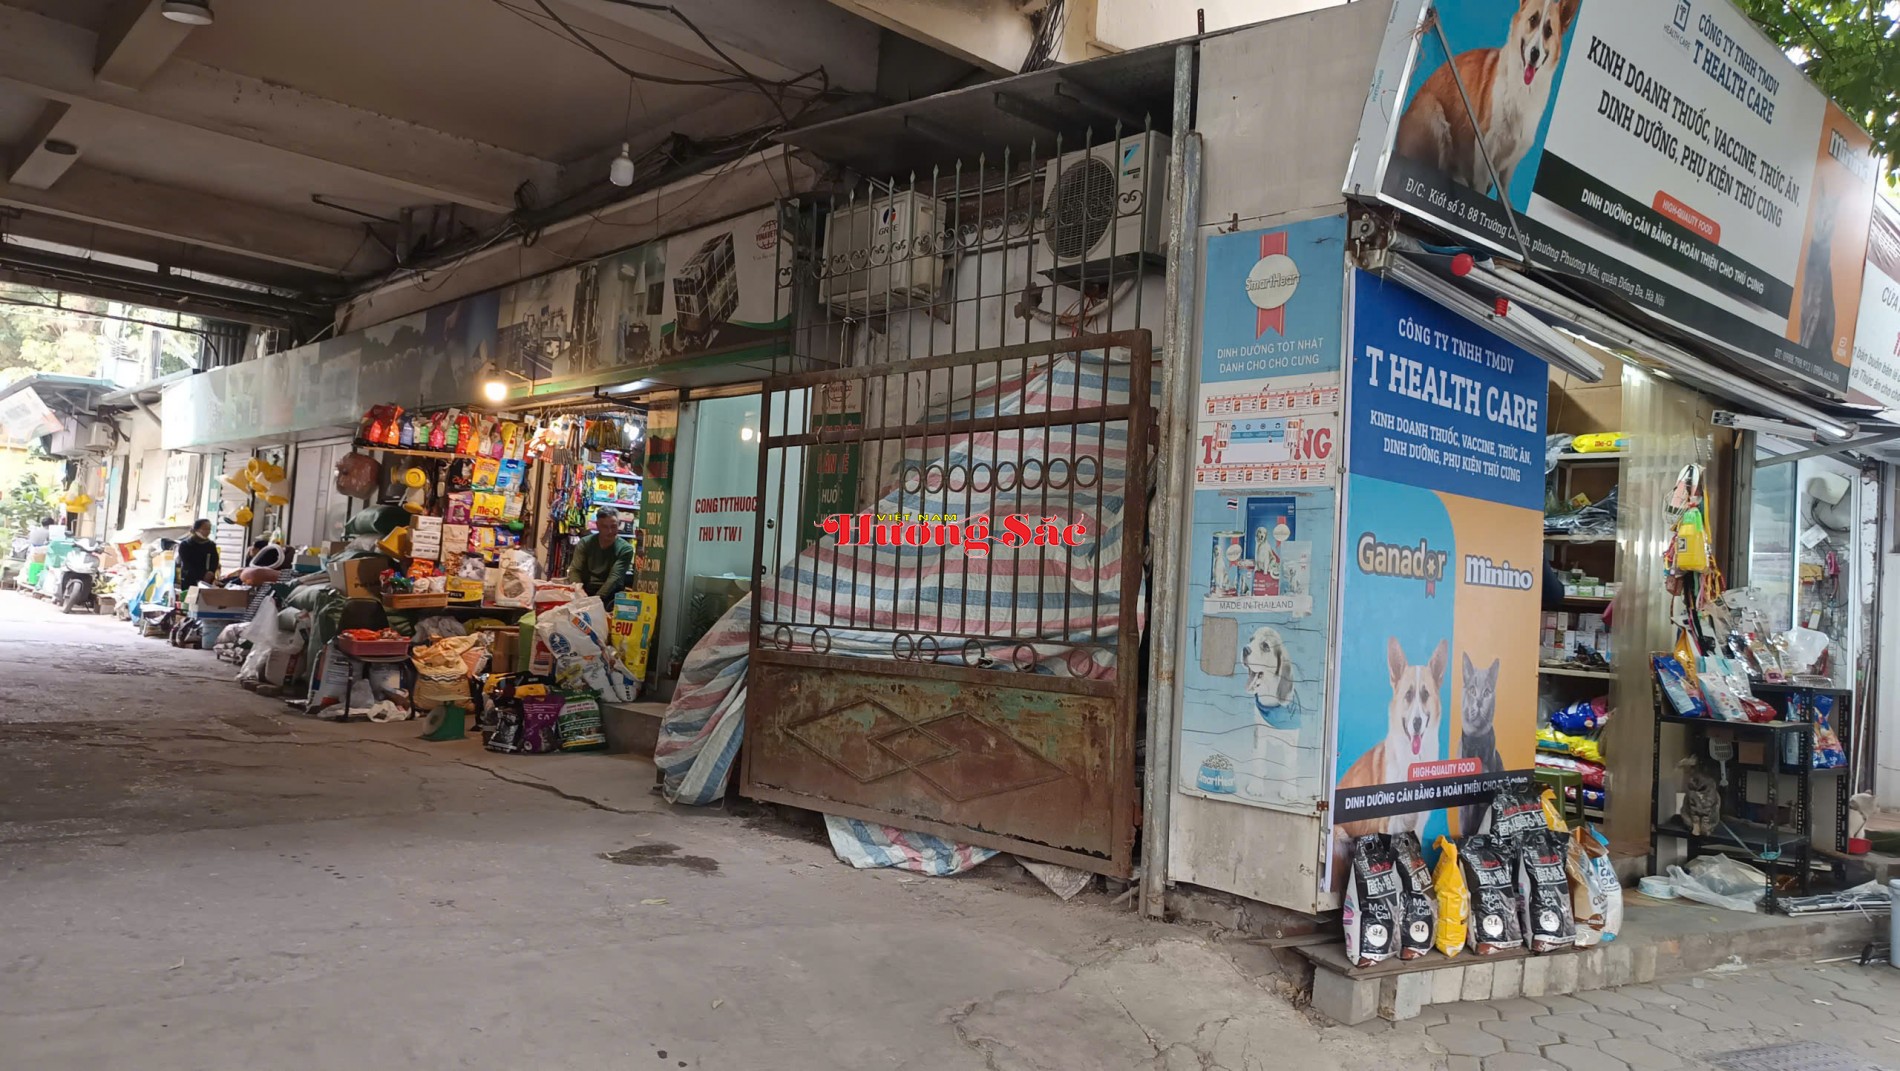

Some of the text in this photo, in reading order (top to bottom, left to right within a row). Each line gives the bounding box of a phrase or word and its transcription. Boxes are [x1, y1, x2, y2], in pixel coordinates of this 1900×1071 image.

[1698, 14, 1780, 97] CÔNG TY TNHH TMDV
[1693, 39, 1775, 125] T HEALTH CARE
[1587, 35, 1800, 207] KINH DOANH THUỐC, VACCINE, THỨC ĂN,
[1597, 90, 1783, 228] DINH DƯỠNG, PHỤ KIỆN THÚ CƯNG
[879, 224, 899, 235] GRE
[1405, 178, 1425, 199] Đ/C:
[1428, 187, 1447, 209] Kiốt
[1447, 196, 1458, 213] số
[1467, 207, 1478, 223] 88
[1478, 211, 1508, 236] Trường
[1531, 238, 1560, 263] phường
[1559, 248, 1587, 275] Phương
[1587, 262, 1600, 278] Mai,
[1645, 287, 1654, 302] Hà
[1662, 199, 1713, 236] HIGH-QUALITY FOOD
[1580, 188, 1603, 211] DINH
[1602, 202, 1633, 226] DƯỠNG
[1633, 216, 1651, 236] CÂN
[1650, 222, 1672, 248] BẰNG
[1672, 237, 1678, 250] &
[1699, 251, 1718, 272] THIỆN
[1718, 261, 1733, 279] CHO
[1733, 268, 1747, 286] THÚ
[1746, 275, 1764, 295] CƯNG
[1217, 348, 1238, 359] DINH
[1398, 317, 1514, 374] CÔNG TY TNHH TMDV
[1366, 345, 1384, 387] T
[1388, 353, 1482, 417] HEALTH
[1486, 386, 1539, 433] CARE
[1370, 409, 1532, 466] KINH DOANH THUỐC, VACCINE, THỨC ĂN,
[1383, 437, 1521, 483] DINH DƯỠNG, PHỤ KIỆN THÚ CƯNG
[477, 506, 500, 516] Me-O
[695, 498, 718, 514] CONG
[716, 526, 723, 541] Y
[723, 526, 738, 541] TW
[1357, 532, 1447, 581] Ganador
[1464, 554, 1534, 591] Minino
[1220, 600, 1294, 610] MADE IN THAILAND
[1412, 761, 1475, 779] HIGH-QUALITY FOOD
[1345, 796, 1365, 810] DINH
[1366, 790, 1395, 807] DƯỠNG
[1396, 786, 1413, 803] CÂN
[1414, 783, 1435, 801] BẰNG
[1436, 788, 1442, 799] &
[1442, 782, 1463, 798] HOÀN
[1464, 779, 1482, 796] THIỆN
[1482, 780, 1497, 792] CHO
